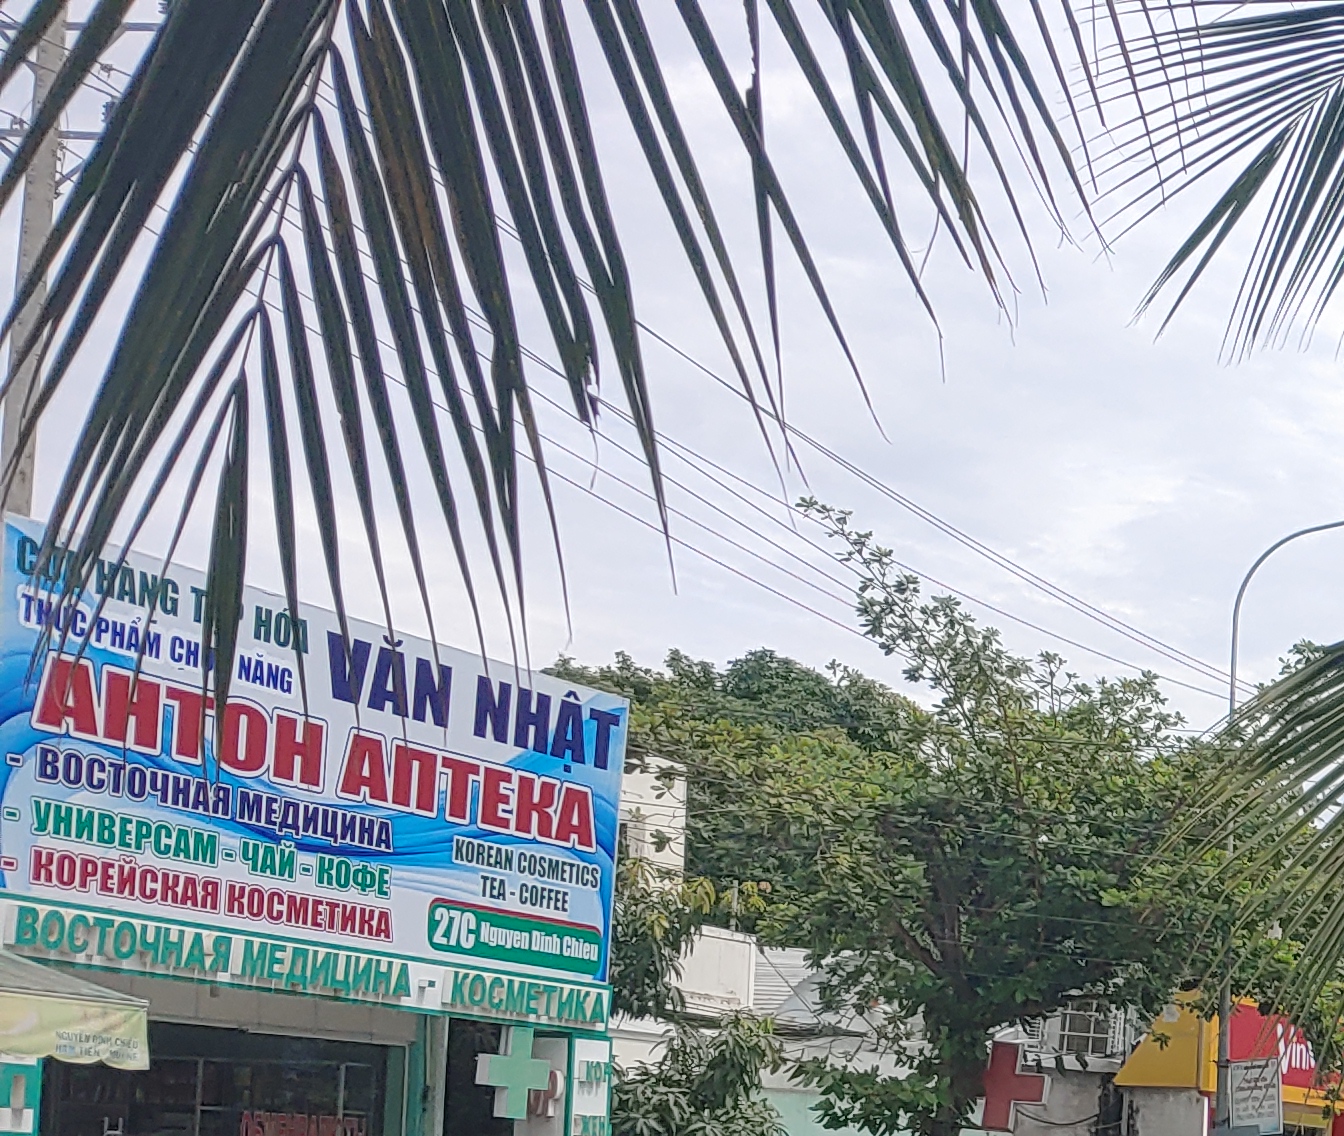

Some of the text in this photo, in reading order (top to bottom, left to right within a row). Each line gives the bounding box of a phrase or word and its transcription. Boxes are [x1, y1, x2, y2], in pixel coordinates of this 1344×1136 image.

[237, 652, 293, 695] NĂNG
[327, 630, 620, 773] VĂN NHẬT
[34, 655, 596, 849] АНТОН АПТЕКА
[37, 746, 392, 850] ВОСТОЧНАЯ МЕДИЦИНА
[31, 847, 392, 940] КОРЕЙСКАЯ КОСМЕТИКА
[32, 799, 218, 864] УНИВЕРСАМ
[241, 837, 296, 882] ЧАЙ
[317, 856, 391, 898] КОФЕ
[455, 838, 599, 889] KOREAN COSMETICS
[481, 875, 506, 901] TEA
[519, 883, 569, 912] COFFEE
[15, 905, 232, 973] ВОСТОЧНАЯ
[242, 939, 412, 998] МЕДИЦИНА
[451, 970, 605, 1024] КОСМЕТИКА
[432, 907, 599, 962] 27C Nguyen Dinh Chieu
